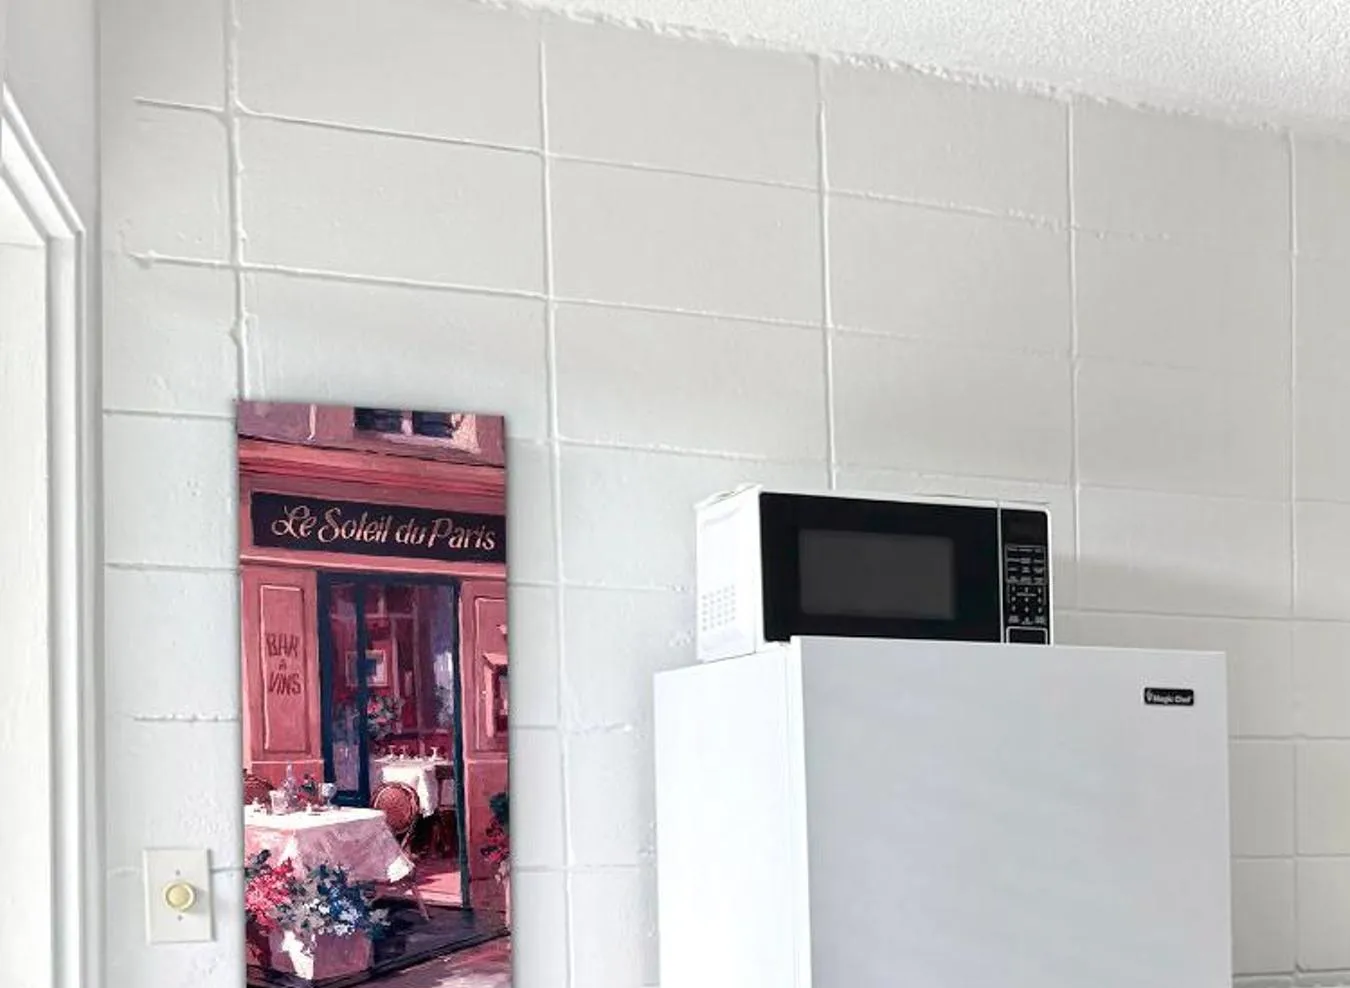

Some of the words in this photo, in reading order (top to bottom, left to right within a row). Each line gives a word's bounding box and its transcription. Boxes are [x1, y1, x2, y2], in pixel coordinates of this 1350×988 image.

[271, 505, 317, 539] Le
[318, 507, 392, 543] Soleil
[395, 517, 427, 545] du
[428, 517, 496, 551] Paris
[265, 633, 300, 657] BAR
[267, 671, 302, 695] VINS
